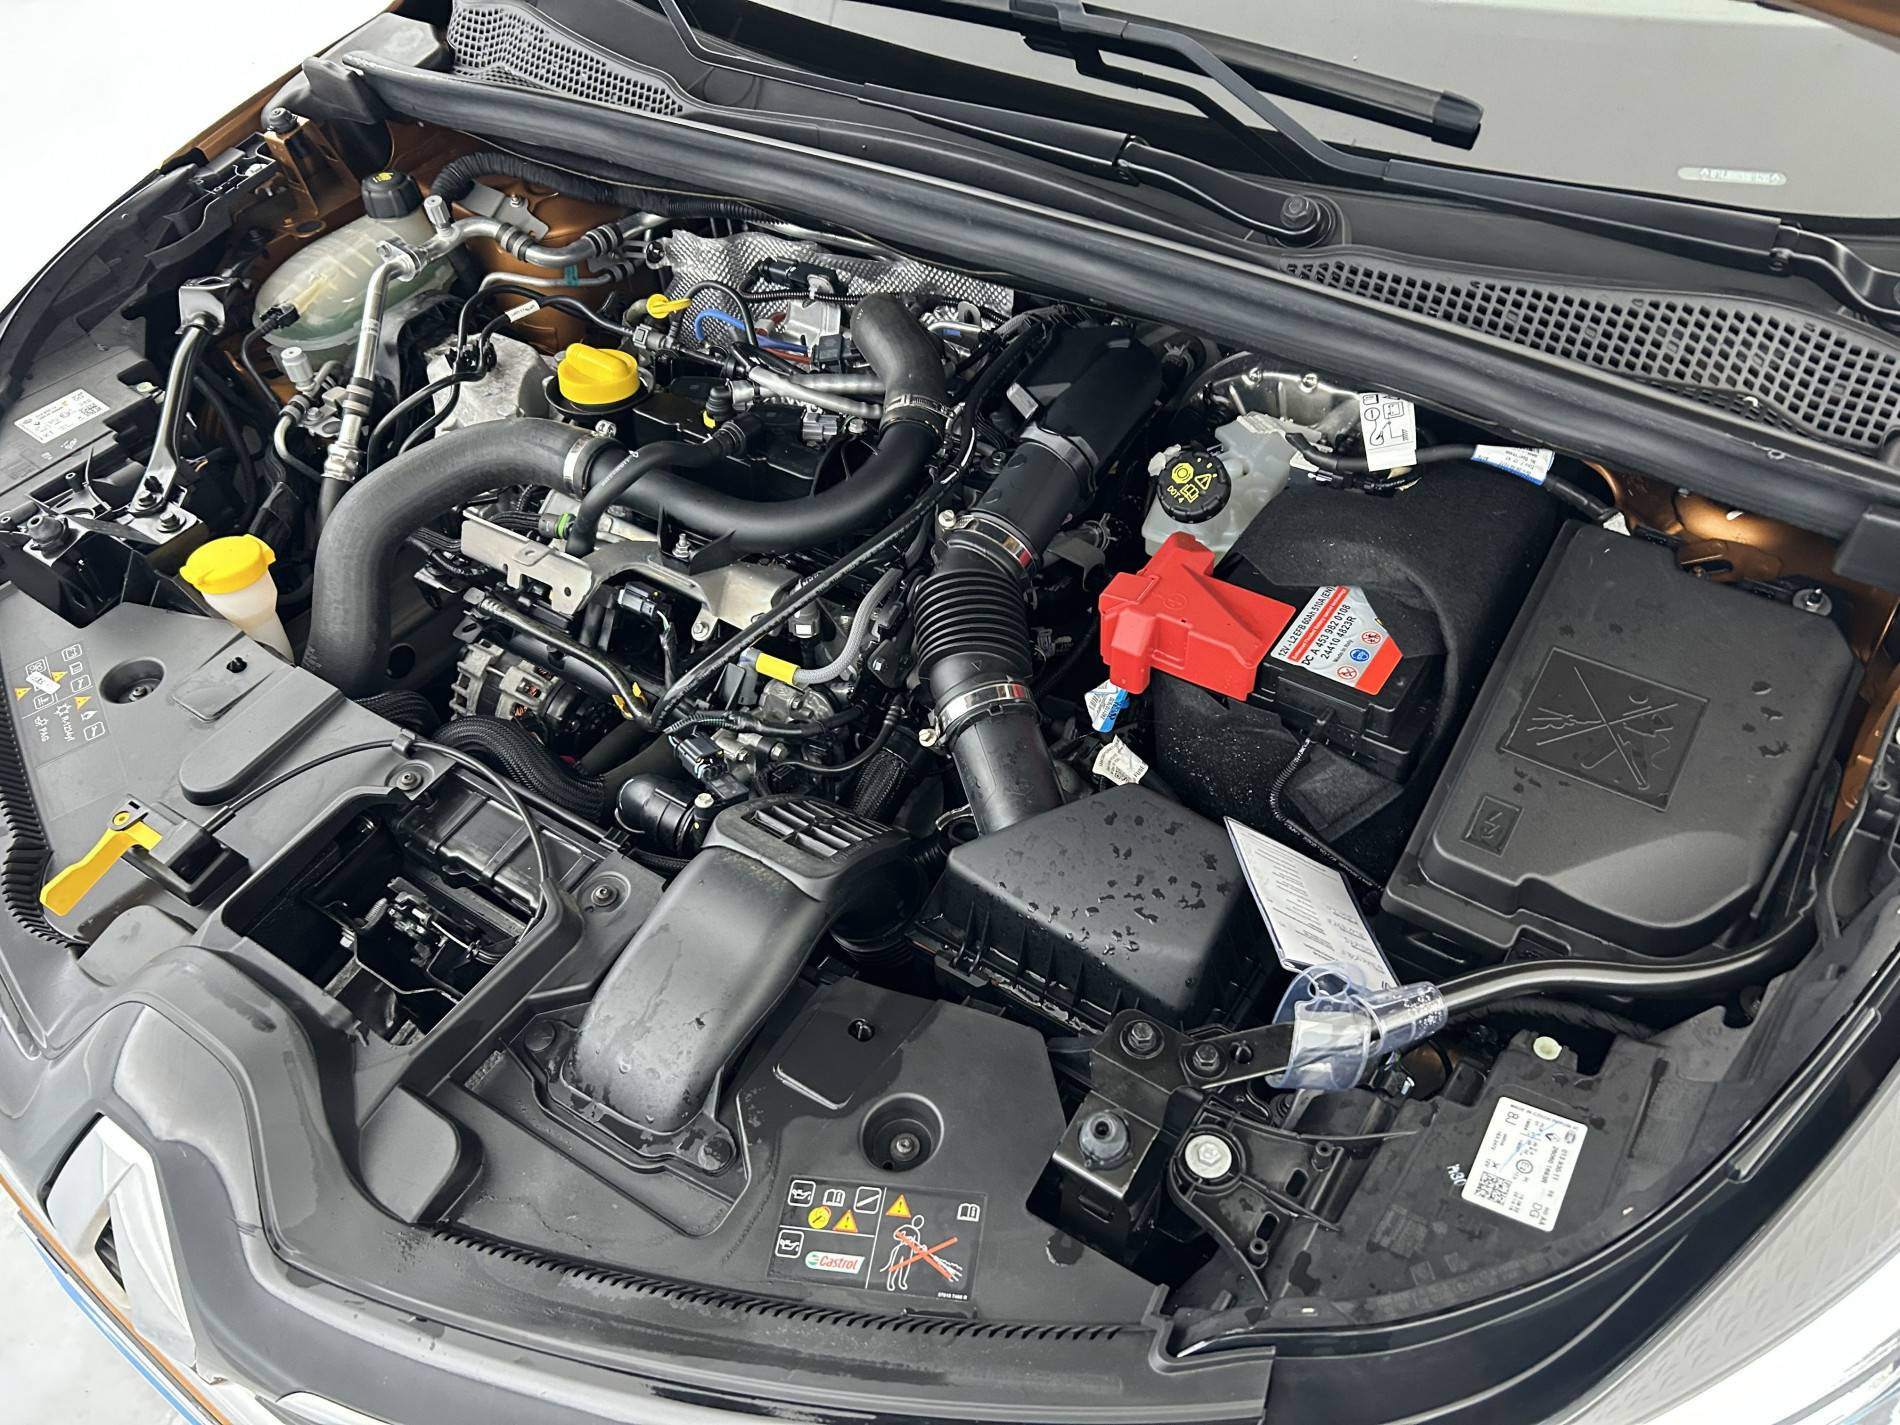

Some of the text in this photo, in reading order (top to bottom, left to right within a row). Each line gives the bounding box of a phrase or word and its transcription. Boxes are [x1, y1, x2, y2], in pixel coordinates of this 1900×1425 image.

[1167, 485, 1180, 498] DOT
[1278, 646, 1290, 656] 12V
[1293, 624, 1306, 636] EFB
[1301, 611, 1316, 625] 60Ah
[1302, 655, 1314, 666] DC
[1316, 634, 1329, 647] 453
[1324, 621, 1339, 634] 982
[1334, 604, 1351, 621] 0108
[1320, 616, 1356, 659] 24410 4823R
[819, 1253, 858, 1271] Castrol
